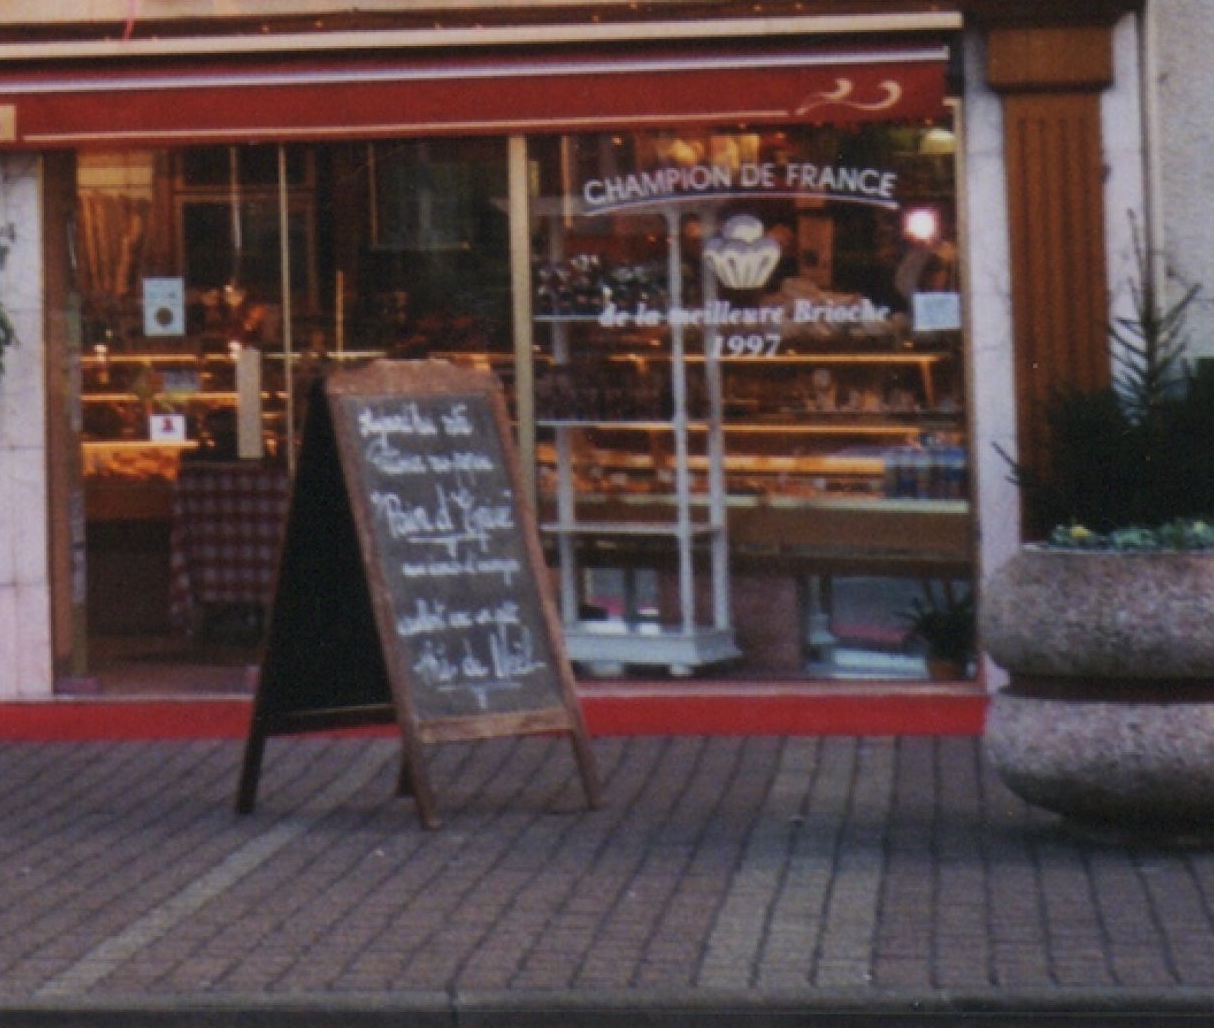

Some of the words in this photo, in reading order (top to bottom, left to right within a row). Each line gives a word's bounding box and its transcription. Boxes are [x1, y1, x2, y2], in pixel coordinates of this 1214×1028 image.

[583, 164, 732, 205] CHAMPION
[740, 162, 776, 188] DE
[786, 162, 898, 199] FRANCE
[792, 297, 892, 324] Brioche
[711, 333, 782, 359] 1997
